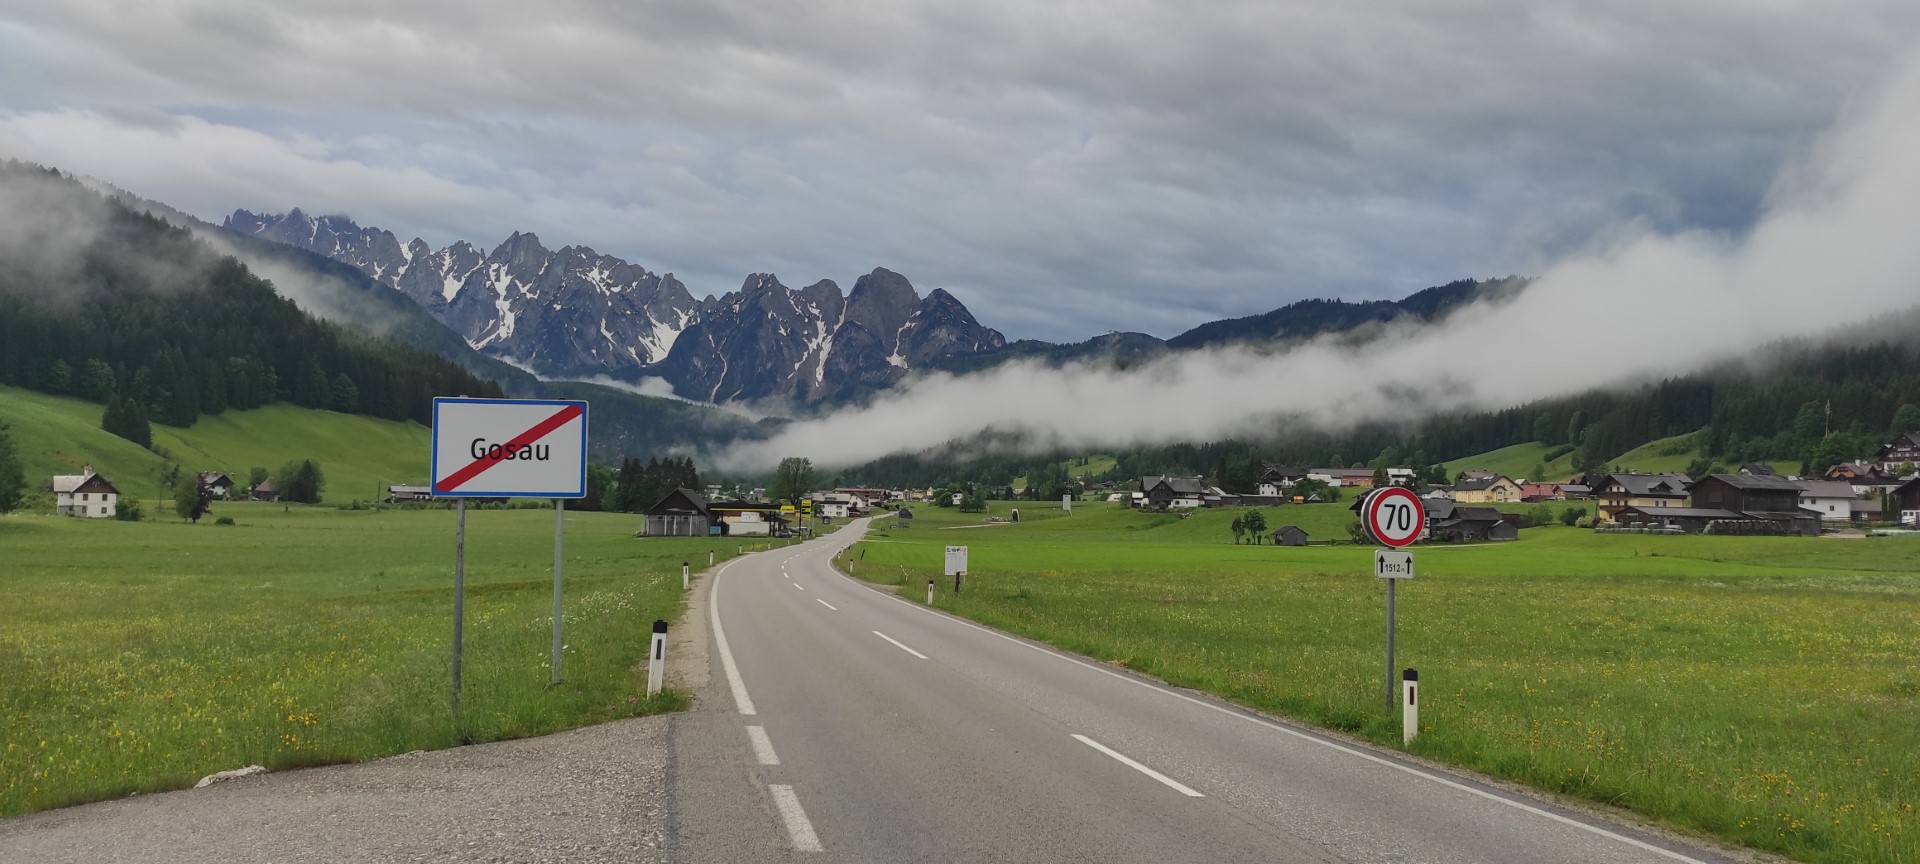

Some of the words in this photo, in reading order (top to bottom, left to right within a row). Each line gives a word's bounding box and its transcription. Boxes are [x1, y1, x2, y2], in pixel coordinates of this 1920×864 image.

[471, 438, 549, 461] Gosau
[1384, 504, 1411, 531] 70
[1385, 563, 1401, 573] 1512
